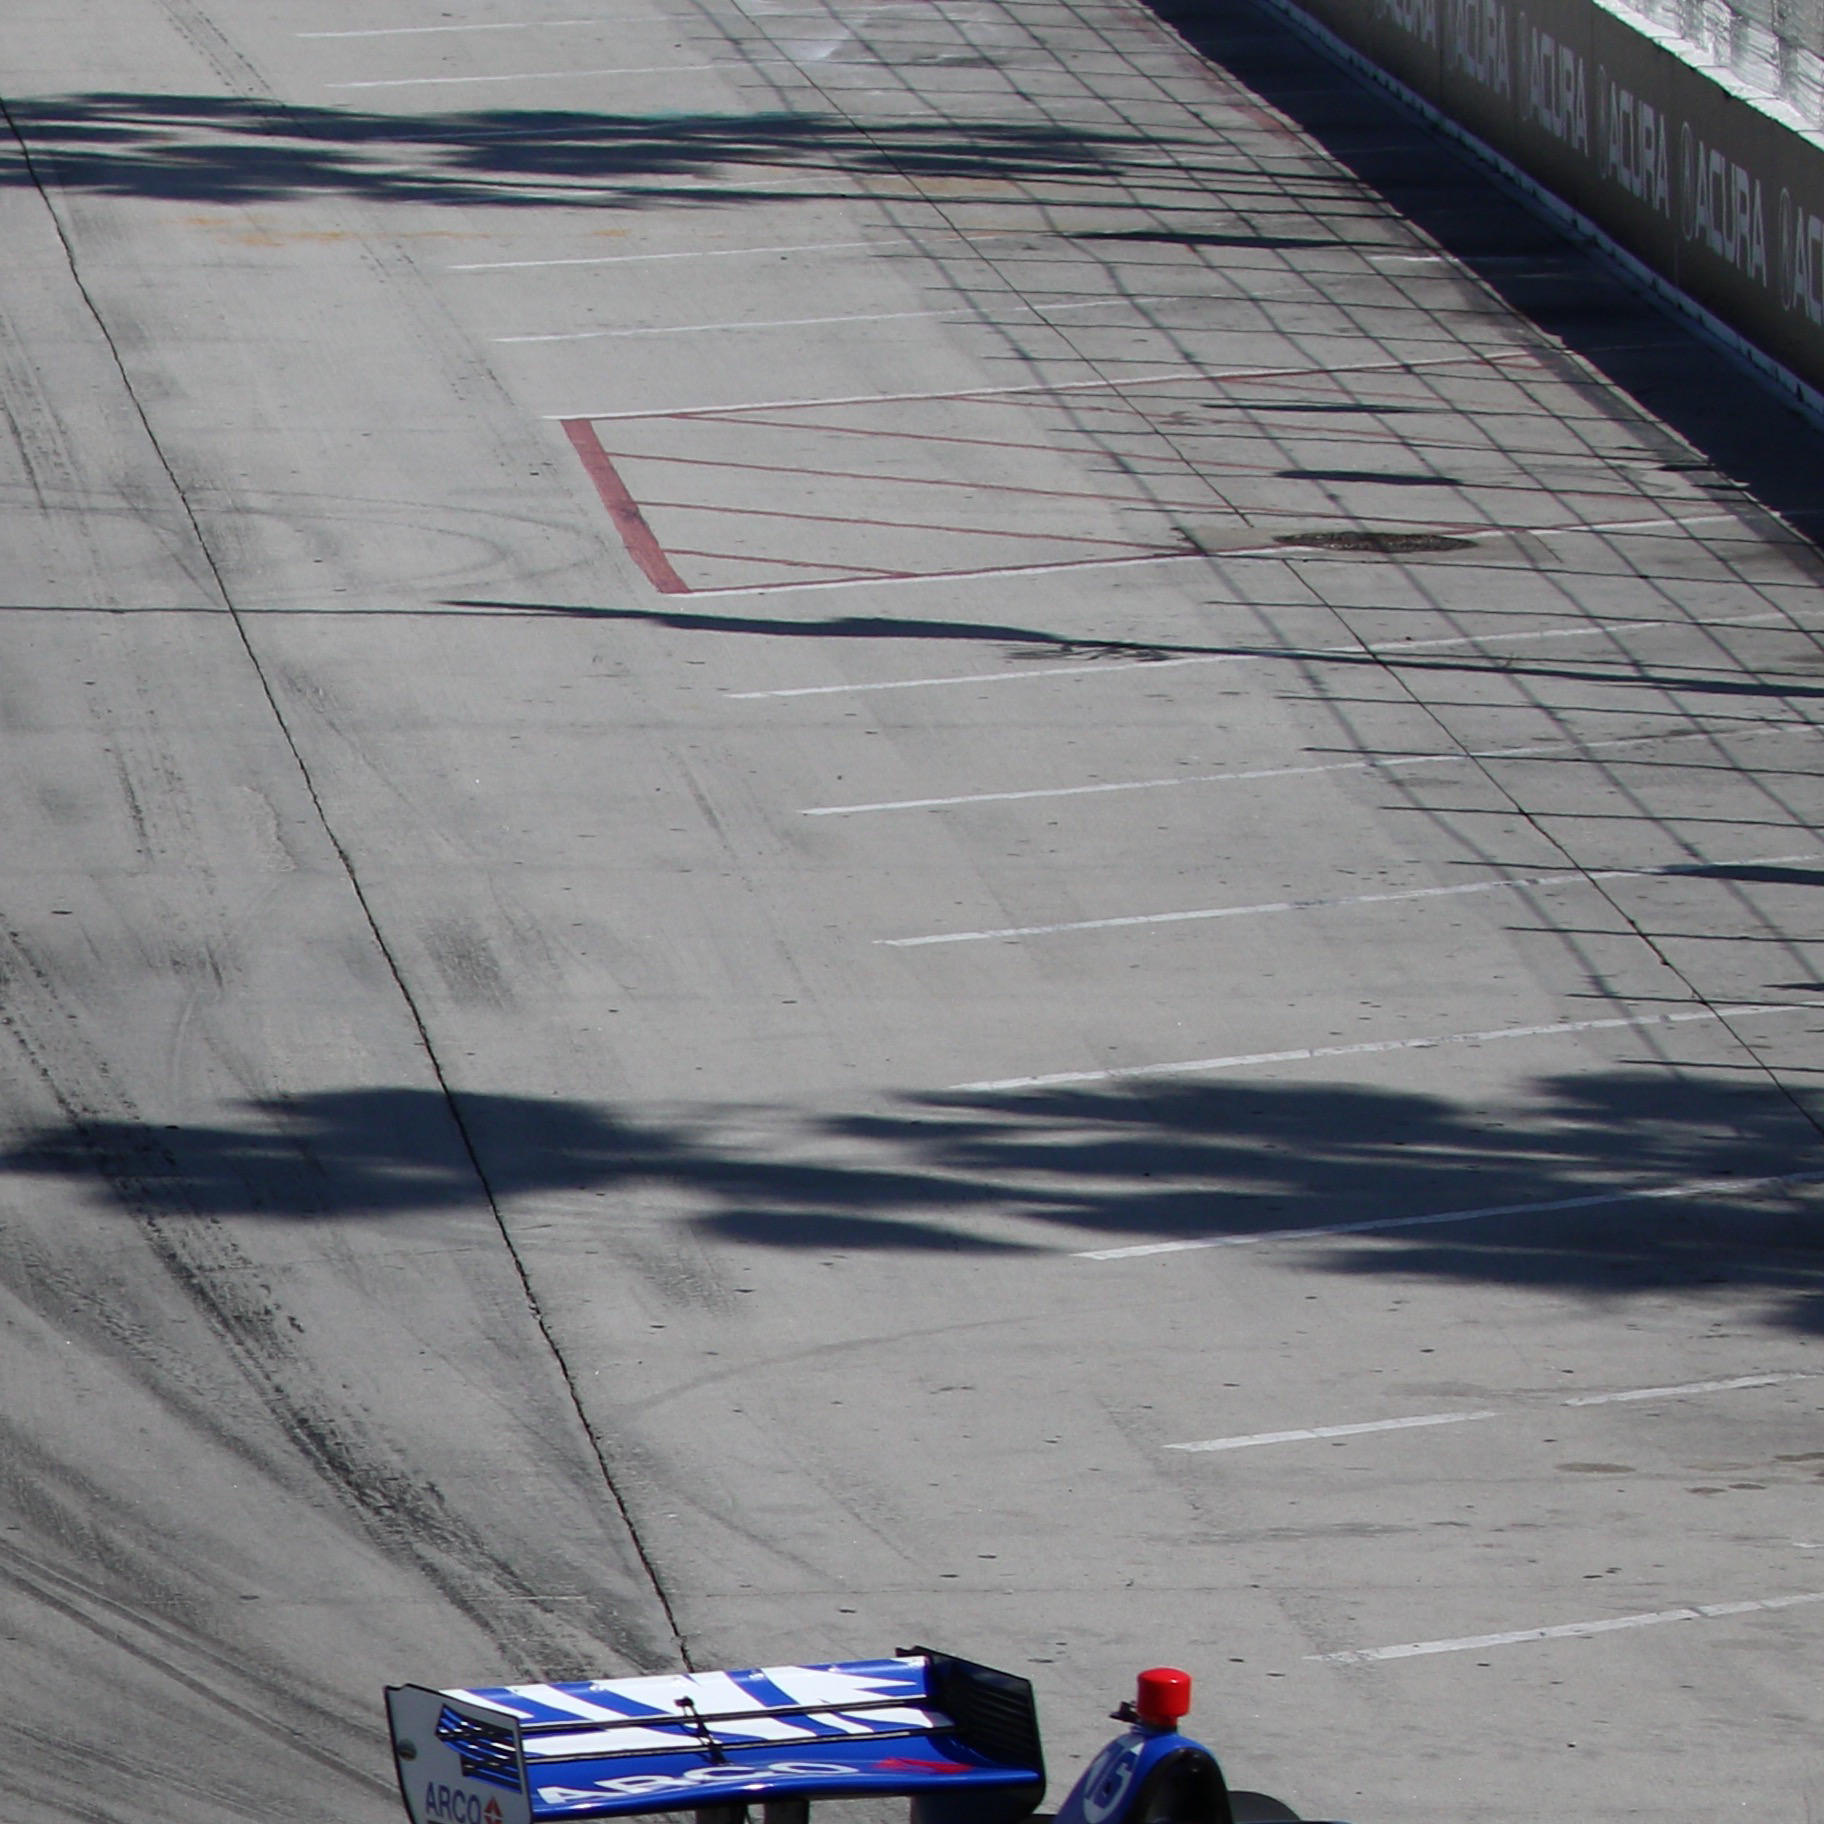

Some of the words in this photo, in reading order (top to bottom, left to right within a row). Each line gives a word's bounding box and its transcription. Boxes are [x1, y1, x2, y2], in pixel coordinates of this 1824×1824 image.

[1530, 27, 1589, 158] ACURA
[1608, 81, 1670, 220] ACURA
[1695, 140, 1768, 288] ACURA
[536, 1761, 859, 1804] ARCO
